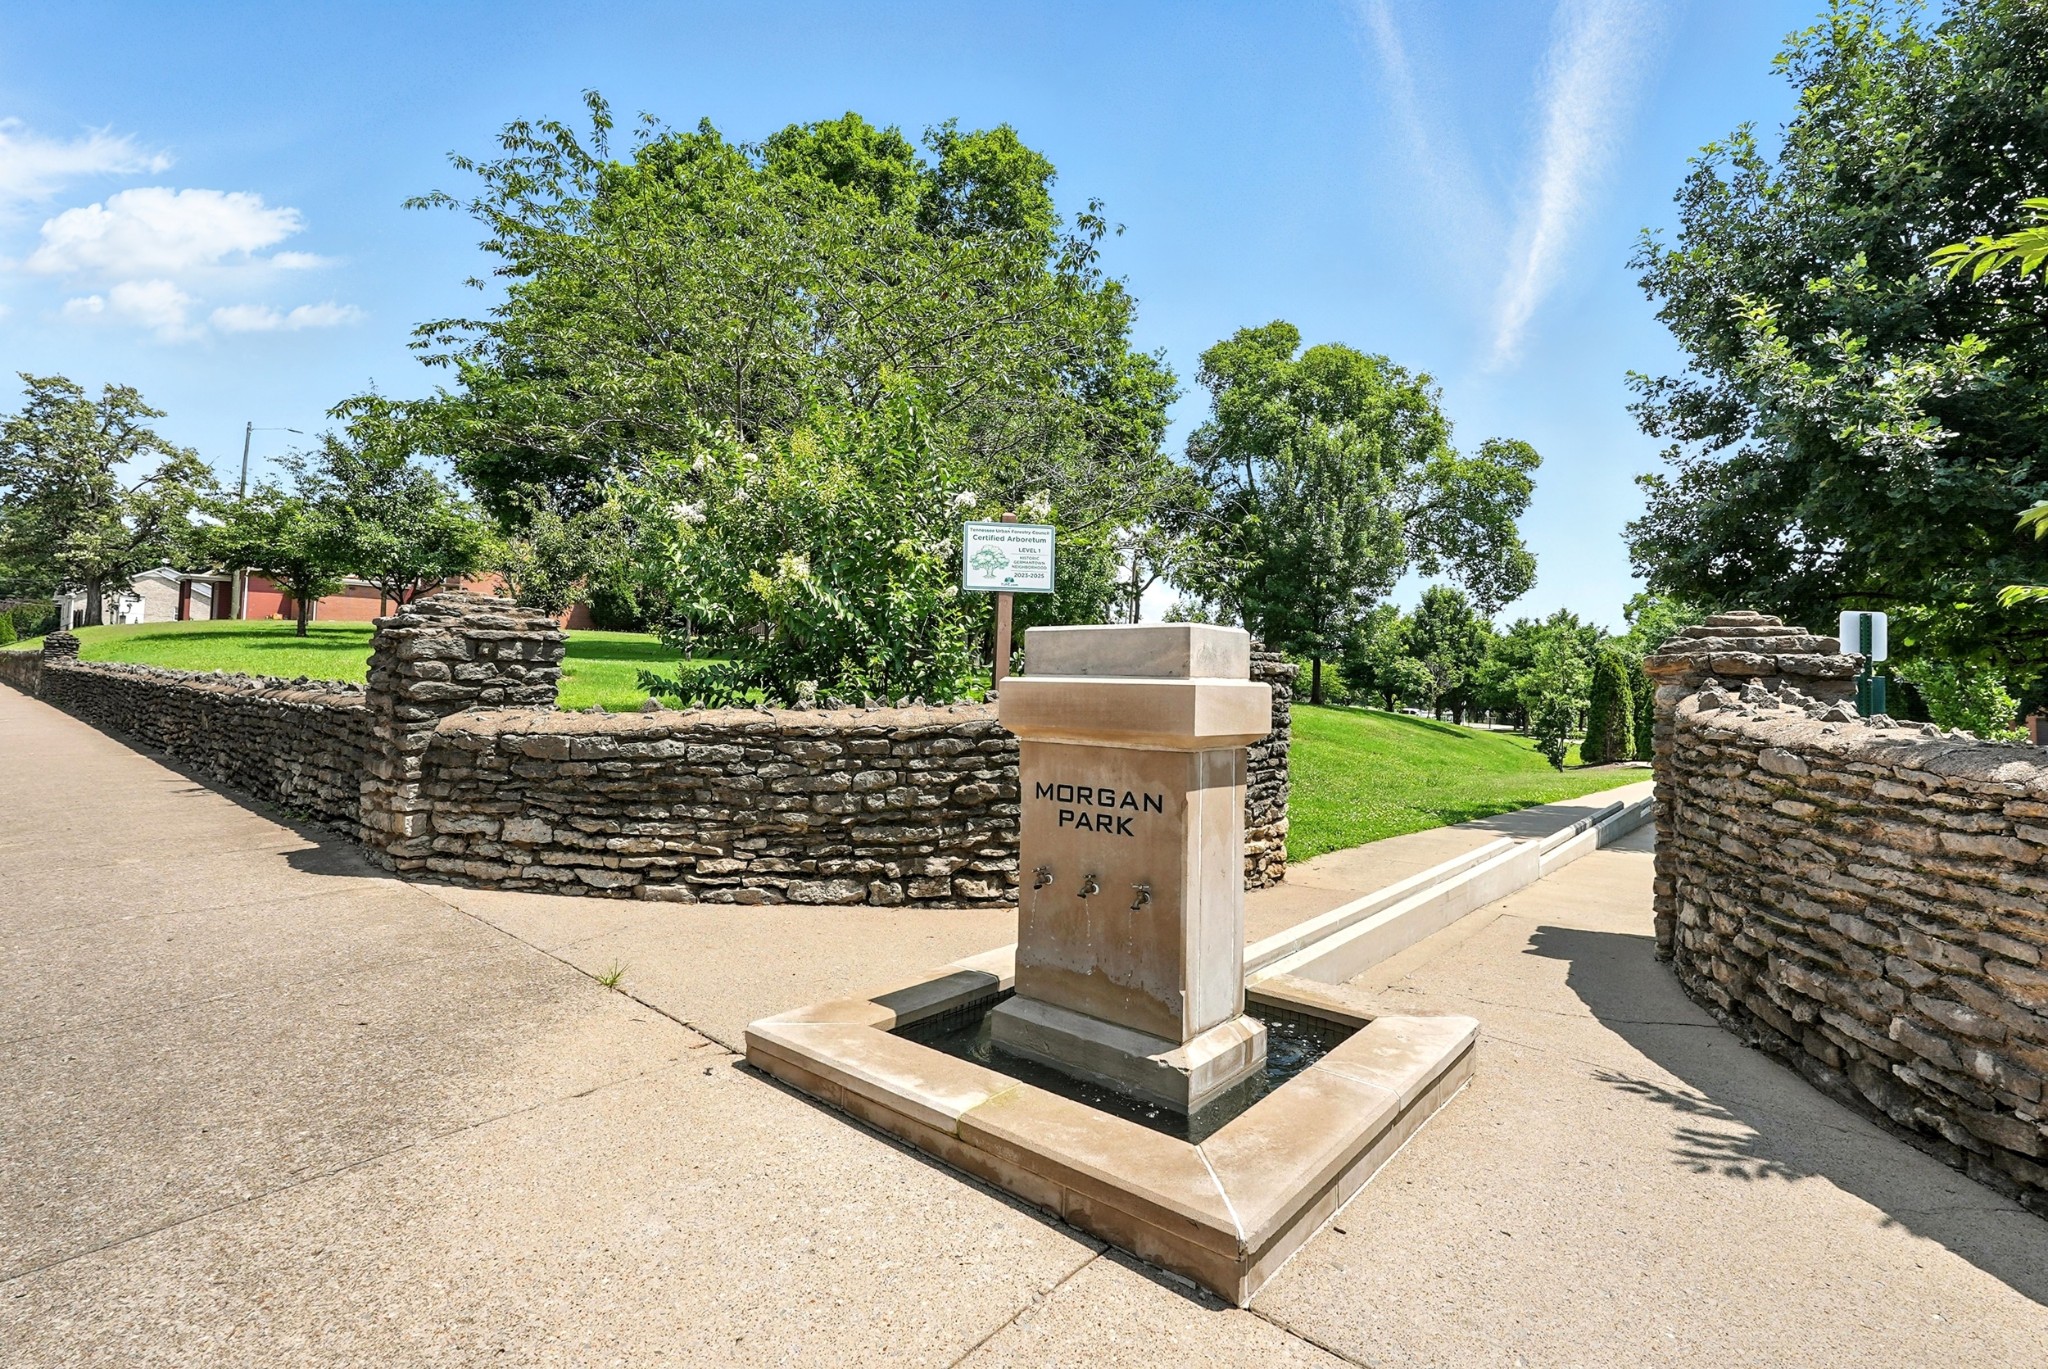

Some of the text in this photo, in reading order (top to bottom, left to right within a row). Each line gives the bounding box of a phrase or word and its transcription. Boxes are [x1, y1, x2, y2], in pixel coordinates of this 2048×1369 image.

[1007, 535, 1047, 543] Arboretum
[1036, 782, 1162, 814] MORGAN
[1058, 809, 1134, 837] PARK
